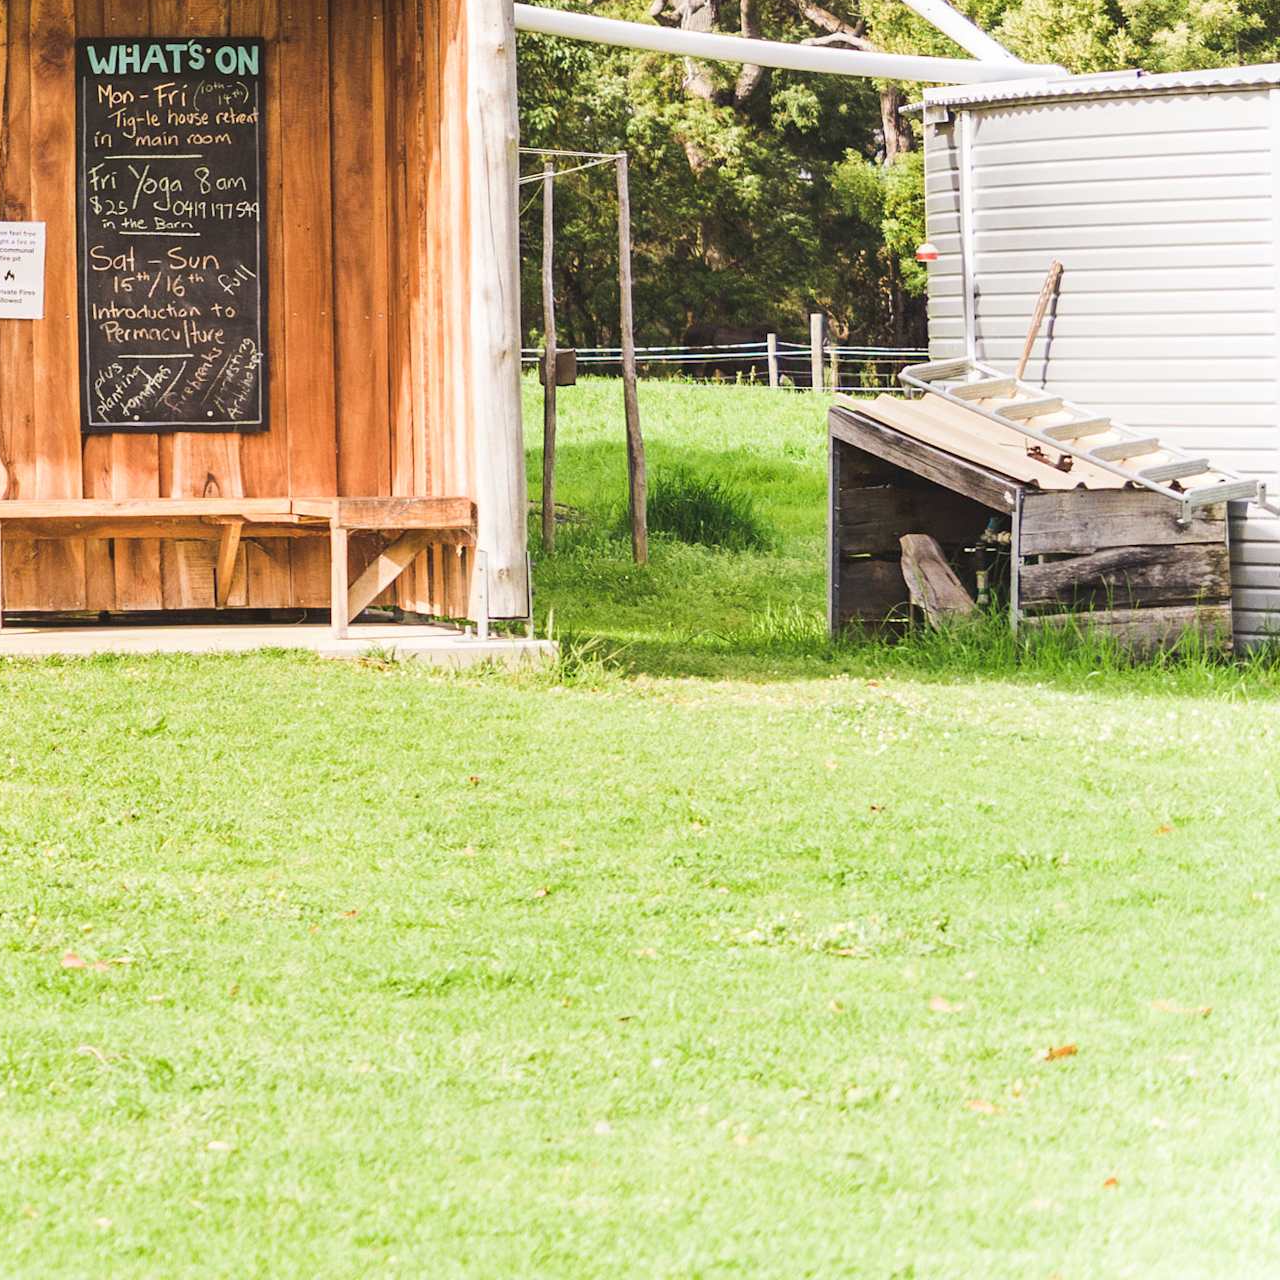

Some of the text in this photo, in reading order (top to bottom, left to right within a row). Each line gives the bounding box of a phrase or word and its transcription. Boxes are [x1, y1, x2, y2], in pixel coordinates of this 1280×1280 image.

[87, 39, 259, 75] WHAT'S ON
[97, 84, 134, 108] Mon
[153, 82, 188, 108] Fri
[167, 109, 209, 125] house
[94, 131, 232, 147] in main room
[88, 163, 117, 191] Fri
[128, 164, 182, 211] Yoga
[89, 195, 129, 216] $25
[101, 217, 194, 230] in the Barn
[90, 245, 136, 272] Sat
[167, 246, 221, 270] Sun
[92, 301, 238, 320] Introduction to
[99, 320, 225, 349] Permaculture
[94, 362, 123, 401] plus
